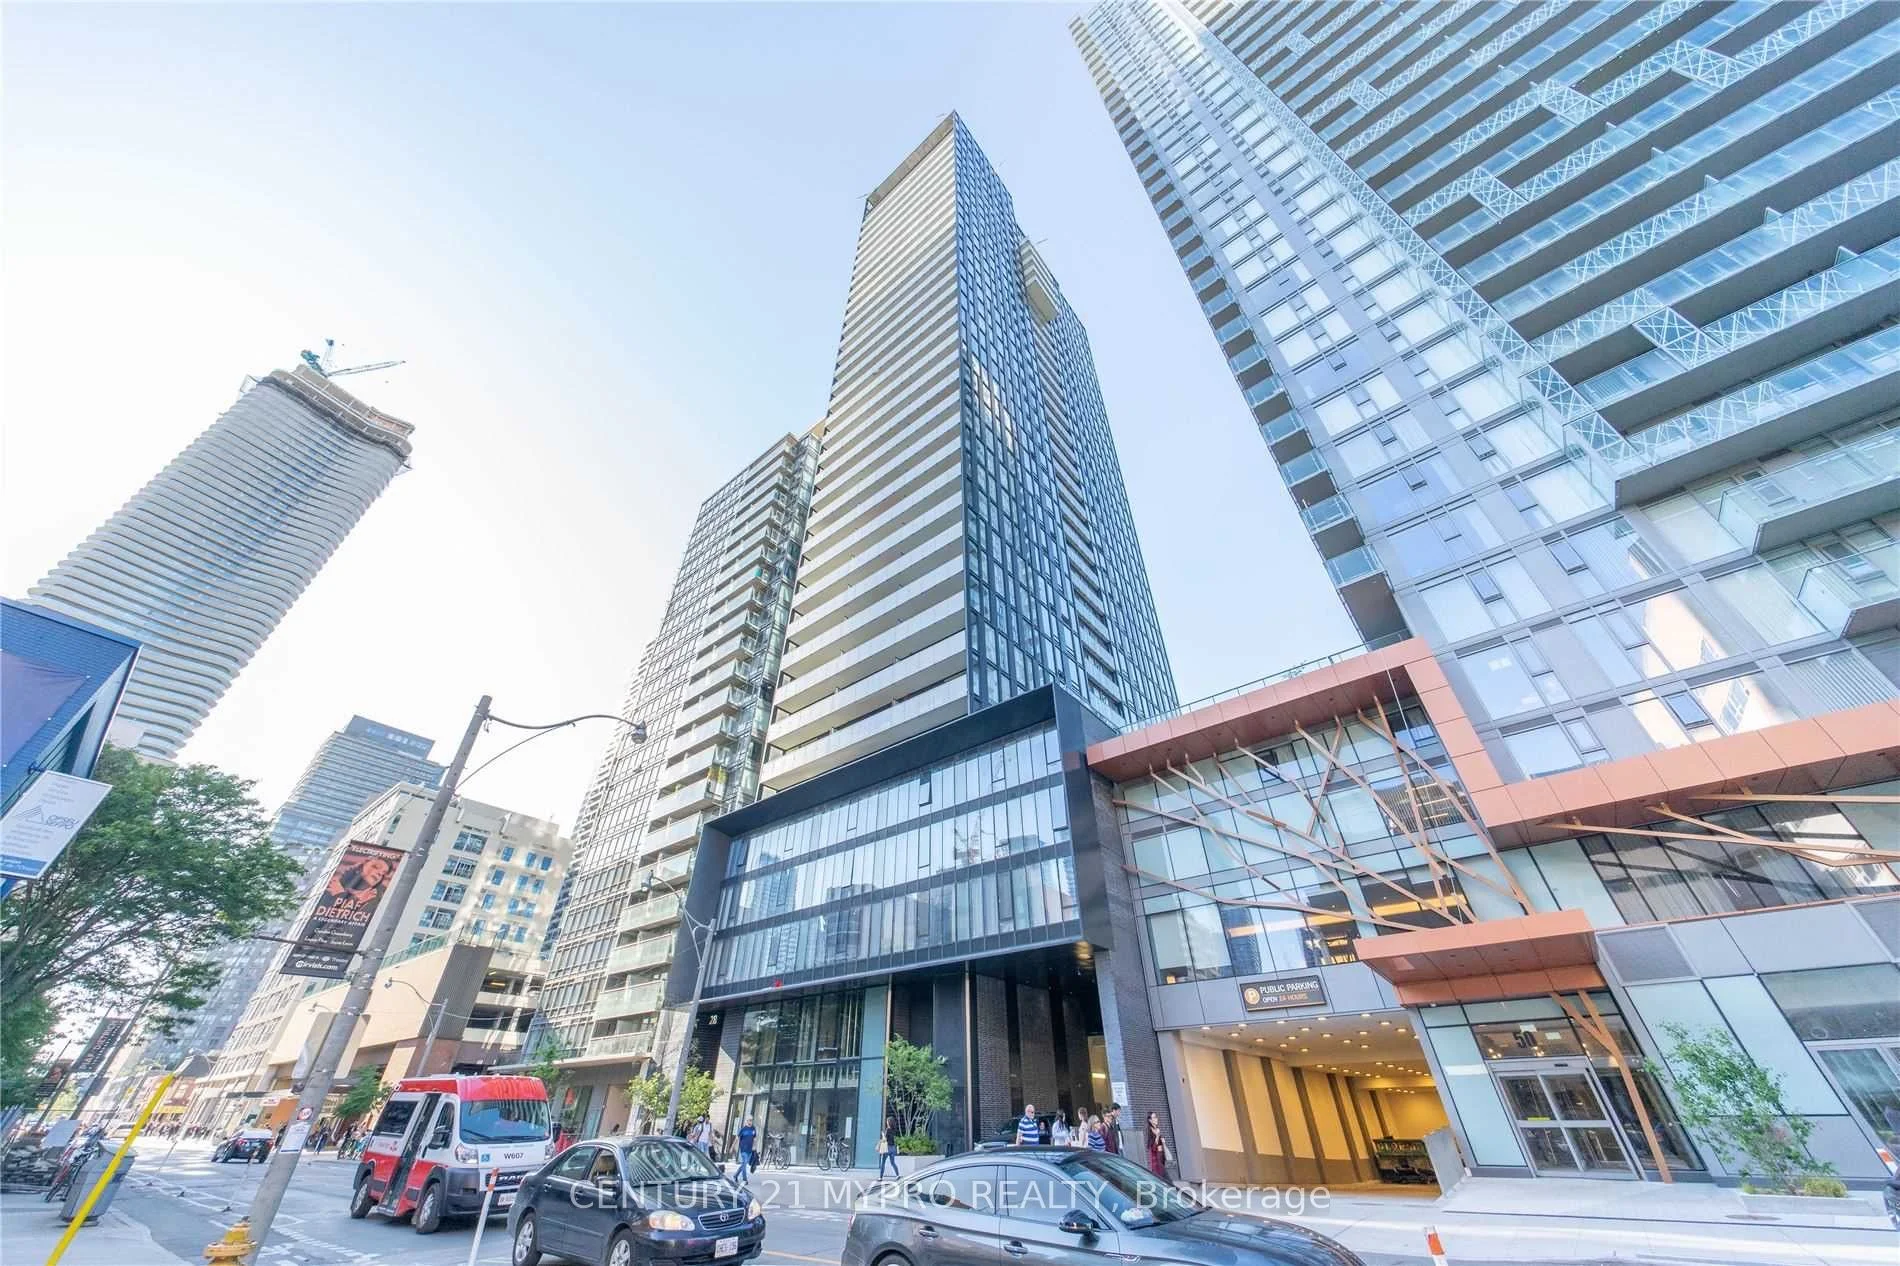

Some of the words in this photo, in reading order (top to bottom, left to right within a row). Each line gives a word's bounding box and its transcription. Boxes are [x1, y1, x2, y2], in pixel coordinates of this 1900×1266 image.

[315, 905, 371, 922] DIETRICH
[1260, 984, 1286, 994] PUBLIC
[1286, 981, 1319, 991] PARKING
[1262, 995, 1278, 1004] OPEN
[1512, 1031, 1537, 1048] 50
[503, 1152, 524, 1160] W607
